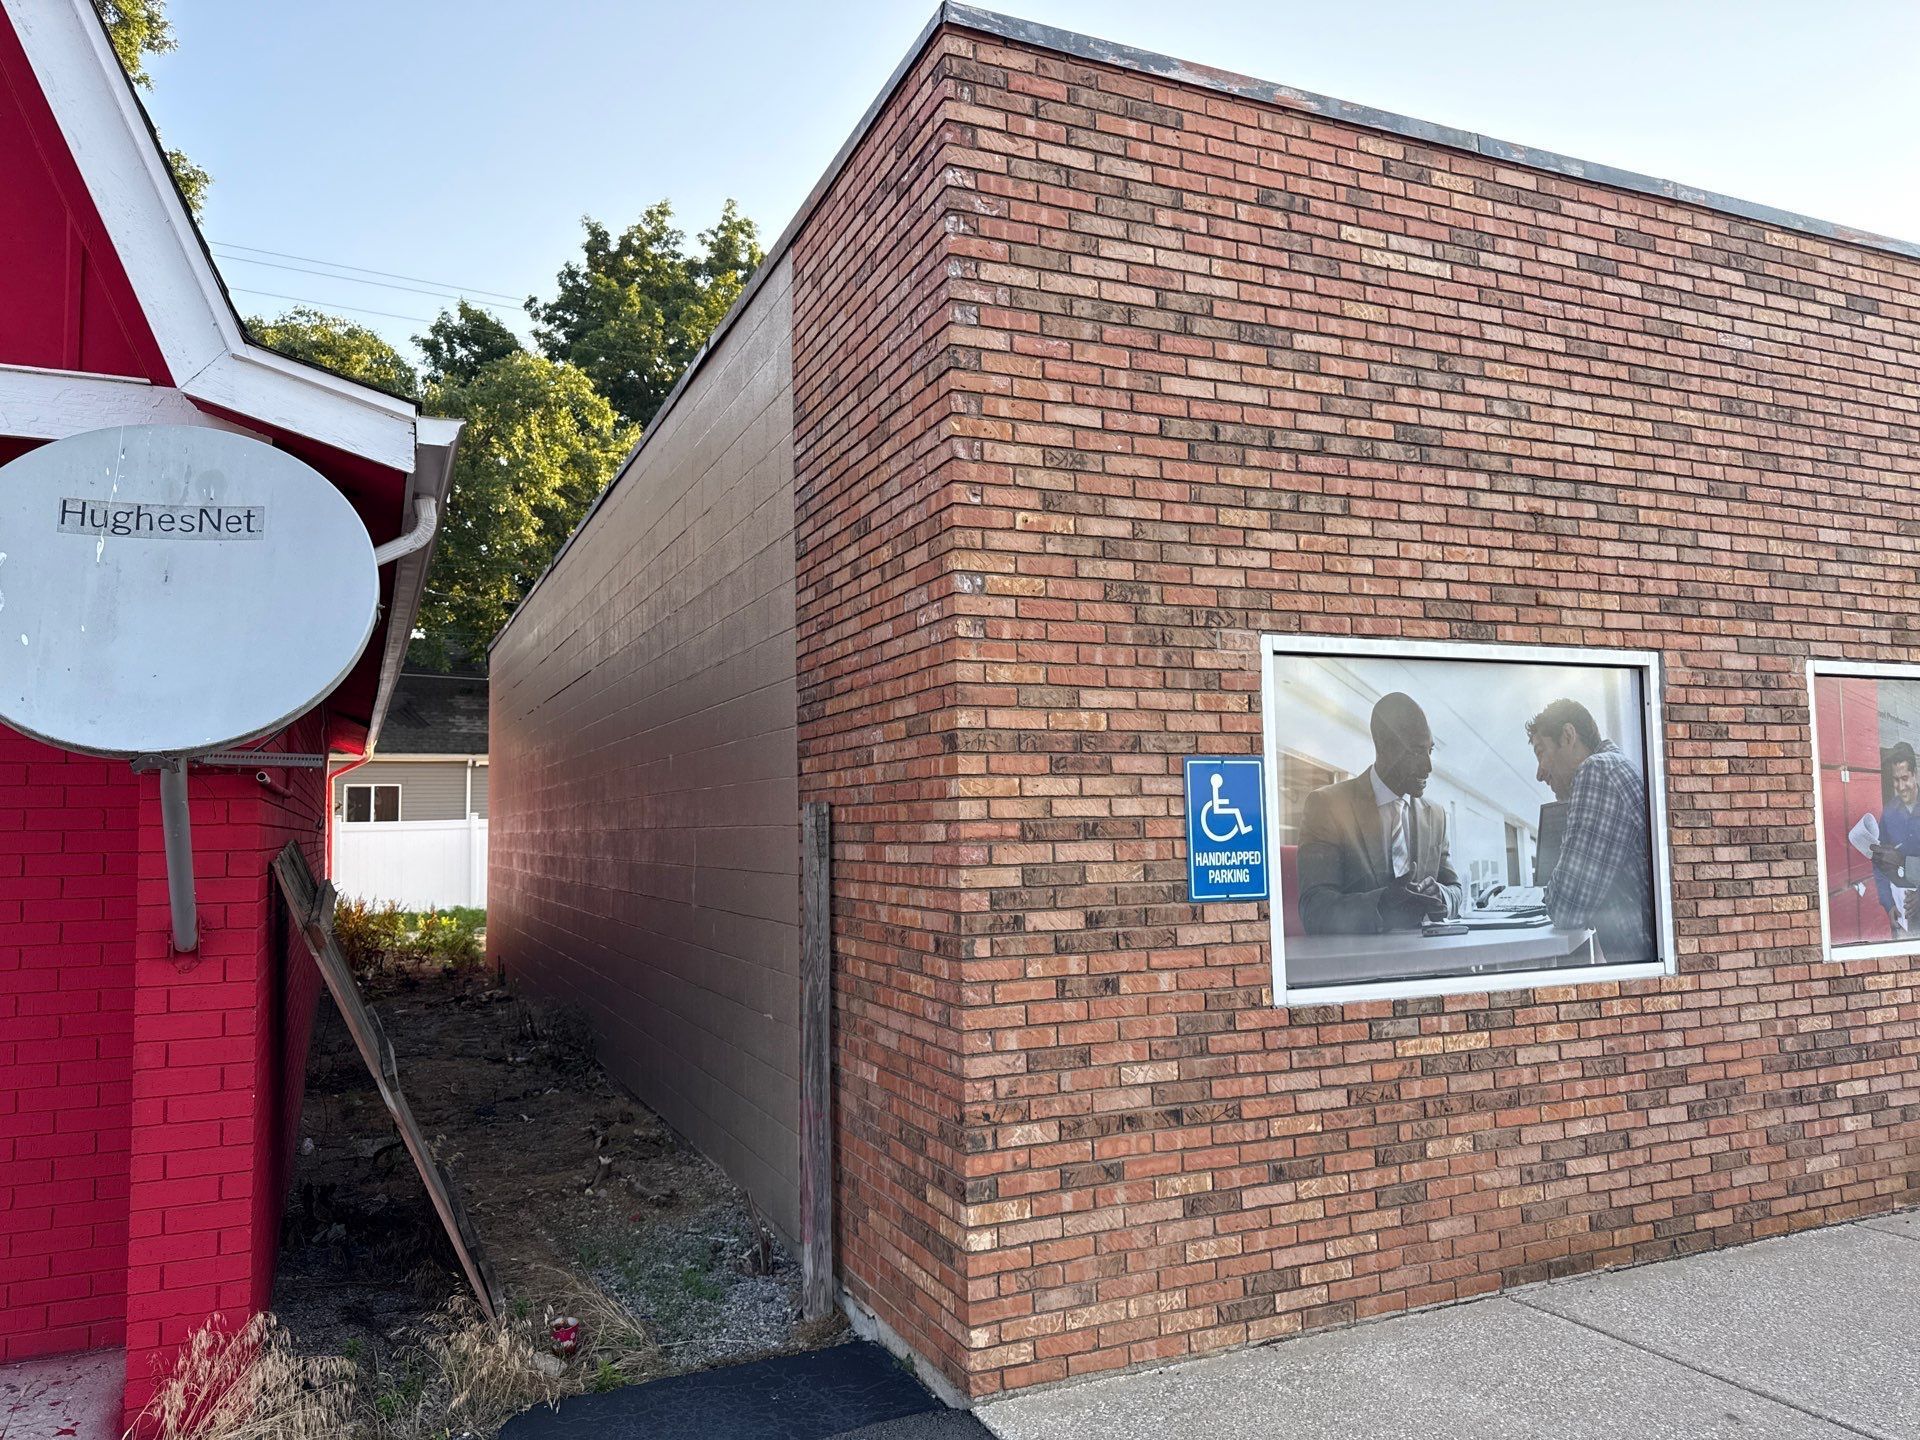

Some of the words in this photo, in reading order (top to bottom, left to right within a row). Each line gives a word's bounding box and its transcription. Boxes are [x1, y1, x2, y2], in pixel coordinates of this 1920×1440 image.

[60, 499, 256, 536] HughesNet
[1195, 851, 1261, 867] HANDICAPPED
[1208, 868, 1250, 884] PARKING
